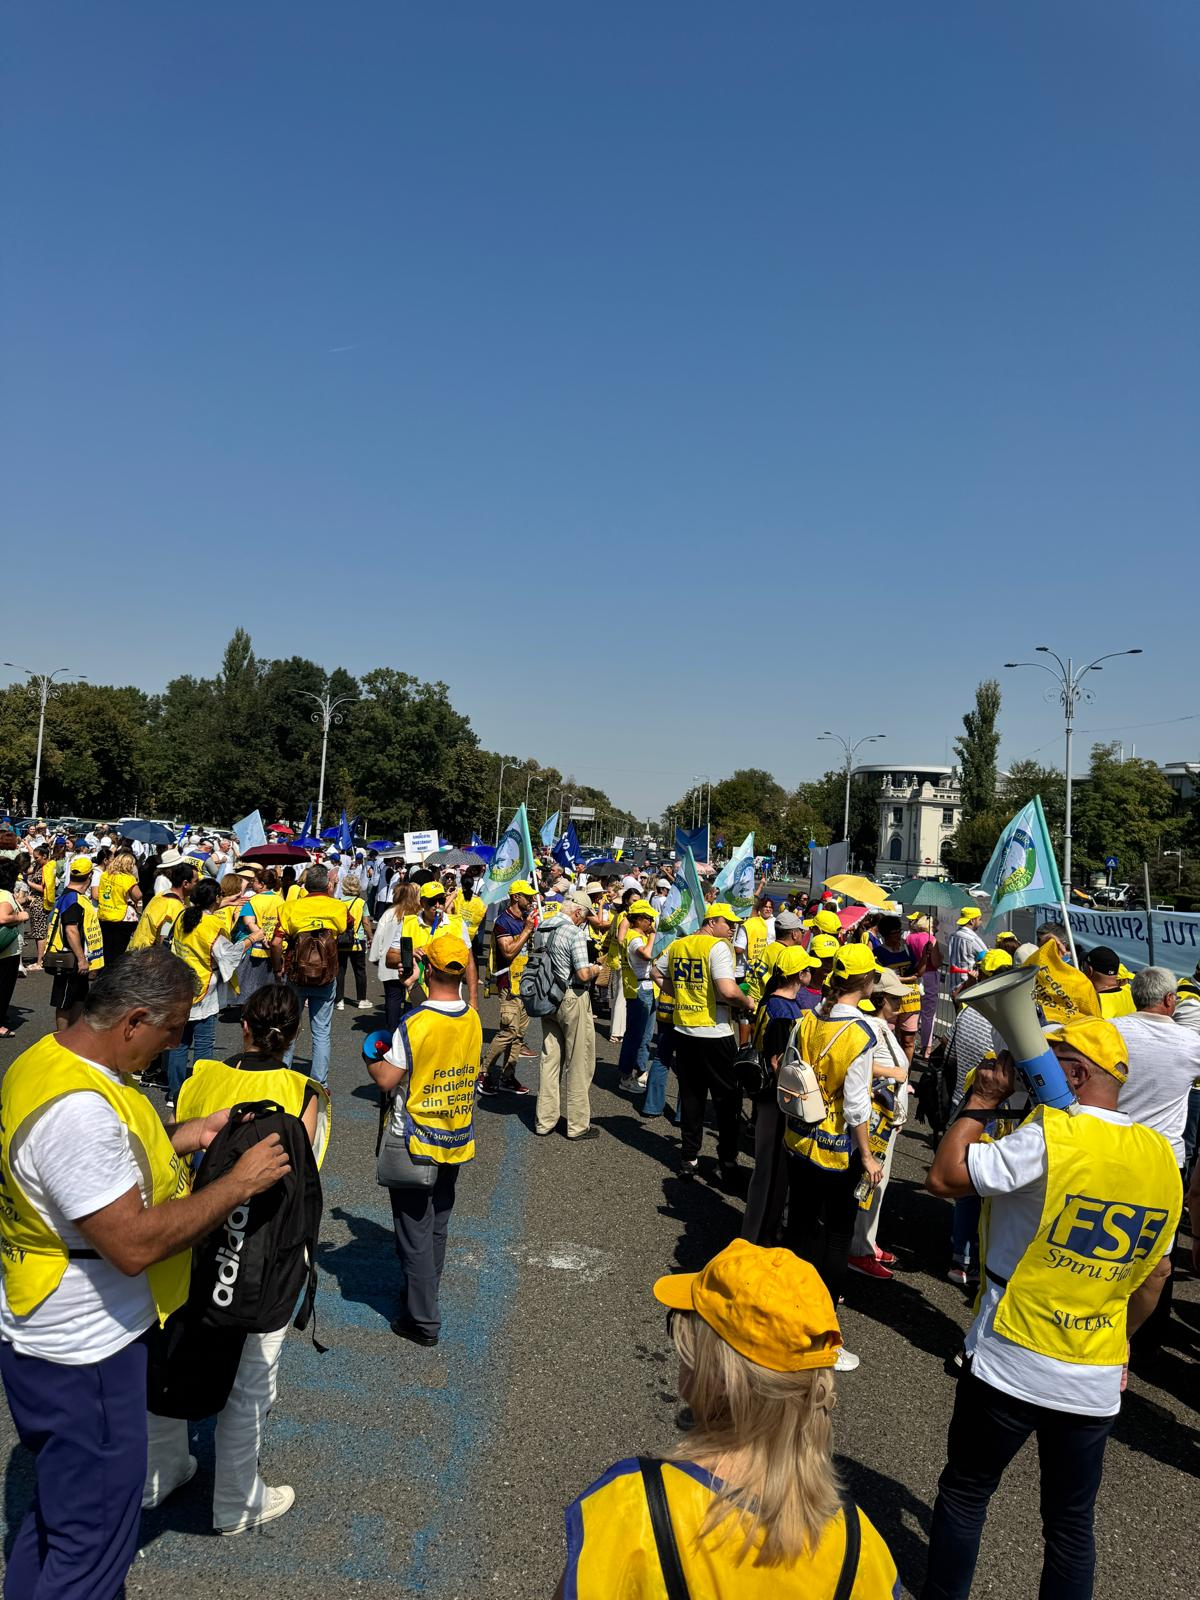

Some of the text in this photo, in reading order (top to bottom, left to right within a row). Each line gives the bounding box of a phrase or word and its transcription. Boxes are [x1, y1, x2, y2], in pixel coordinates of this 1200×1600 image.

[421, 1097, 443, 1108] din
[212, 1198, 251, 1307] adida
[1051, 1197, 1167, 1261] FSE
[1042, 1248, 1102, 1279] Spiru
